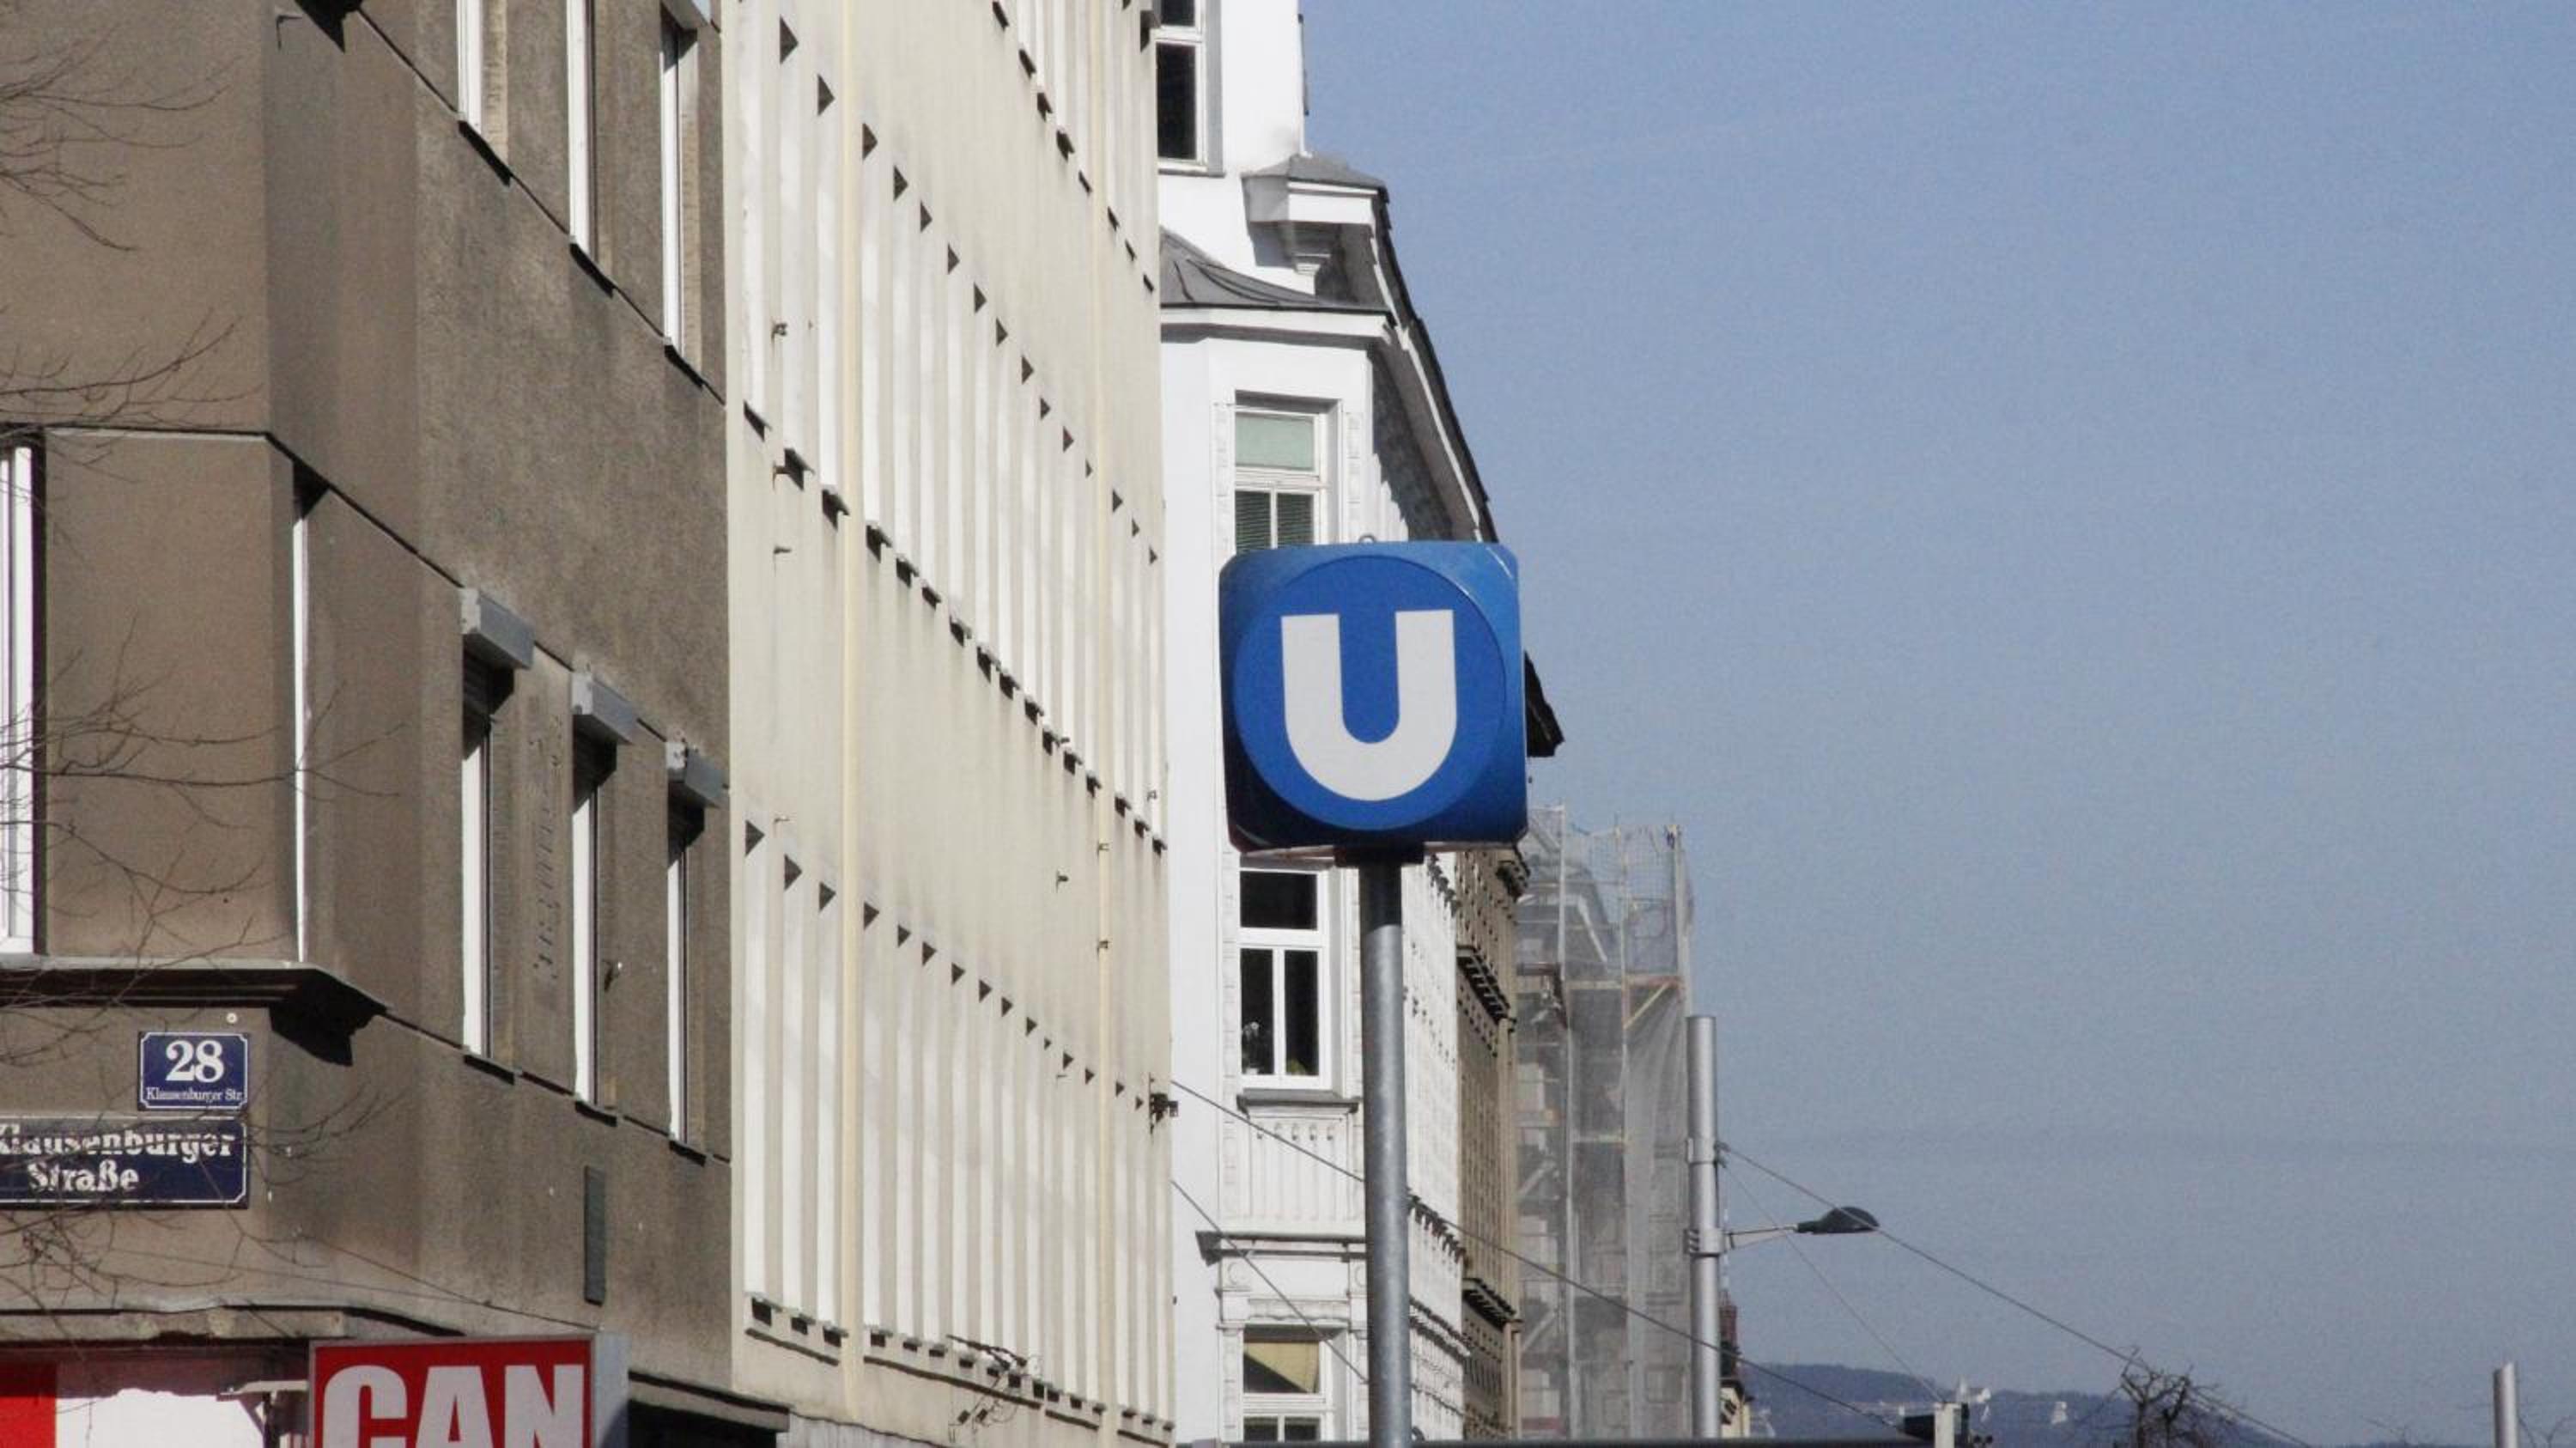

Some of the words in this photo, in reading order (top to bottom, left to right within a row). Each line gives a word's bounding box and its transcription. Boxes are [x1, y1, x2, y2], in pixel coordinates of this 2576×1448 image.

[1281, 609, 1456, 801] U
[165, 1040, 224, 1082] 28
[27, 1159, 140, 1192] Straße
[322, 1364, 585, 1448] CAN
